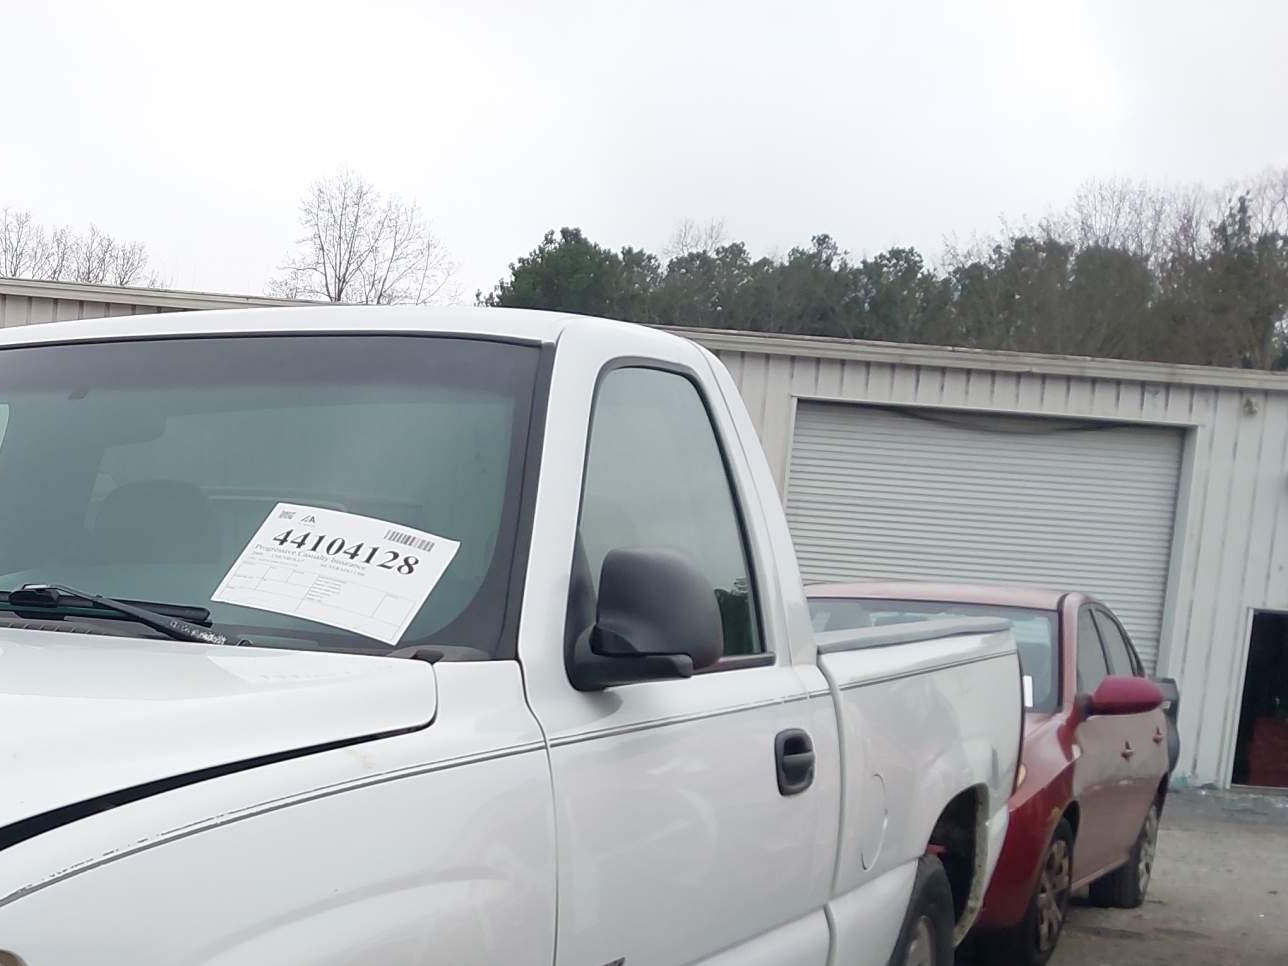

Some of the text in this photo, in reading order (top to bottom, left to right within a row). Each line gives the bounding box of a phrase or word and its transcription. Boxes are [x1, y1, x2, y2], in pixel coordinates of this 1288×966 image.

[273, 529, 420, 576] 44104128
[298, 549, 329, 562] Casualty
[331, 556, 367, 571] Insurance
